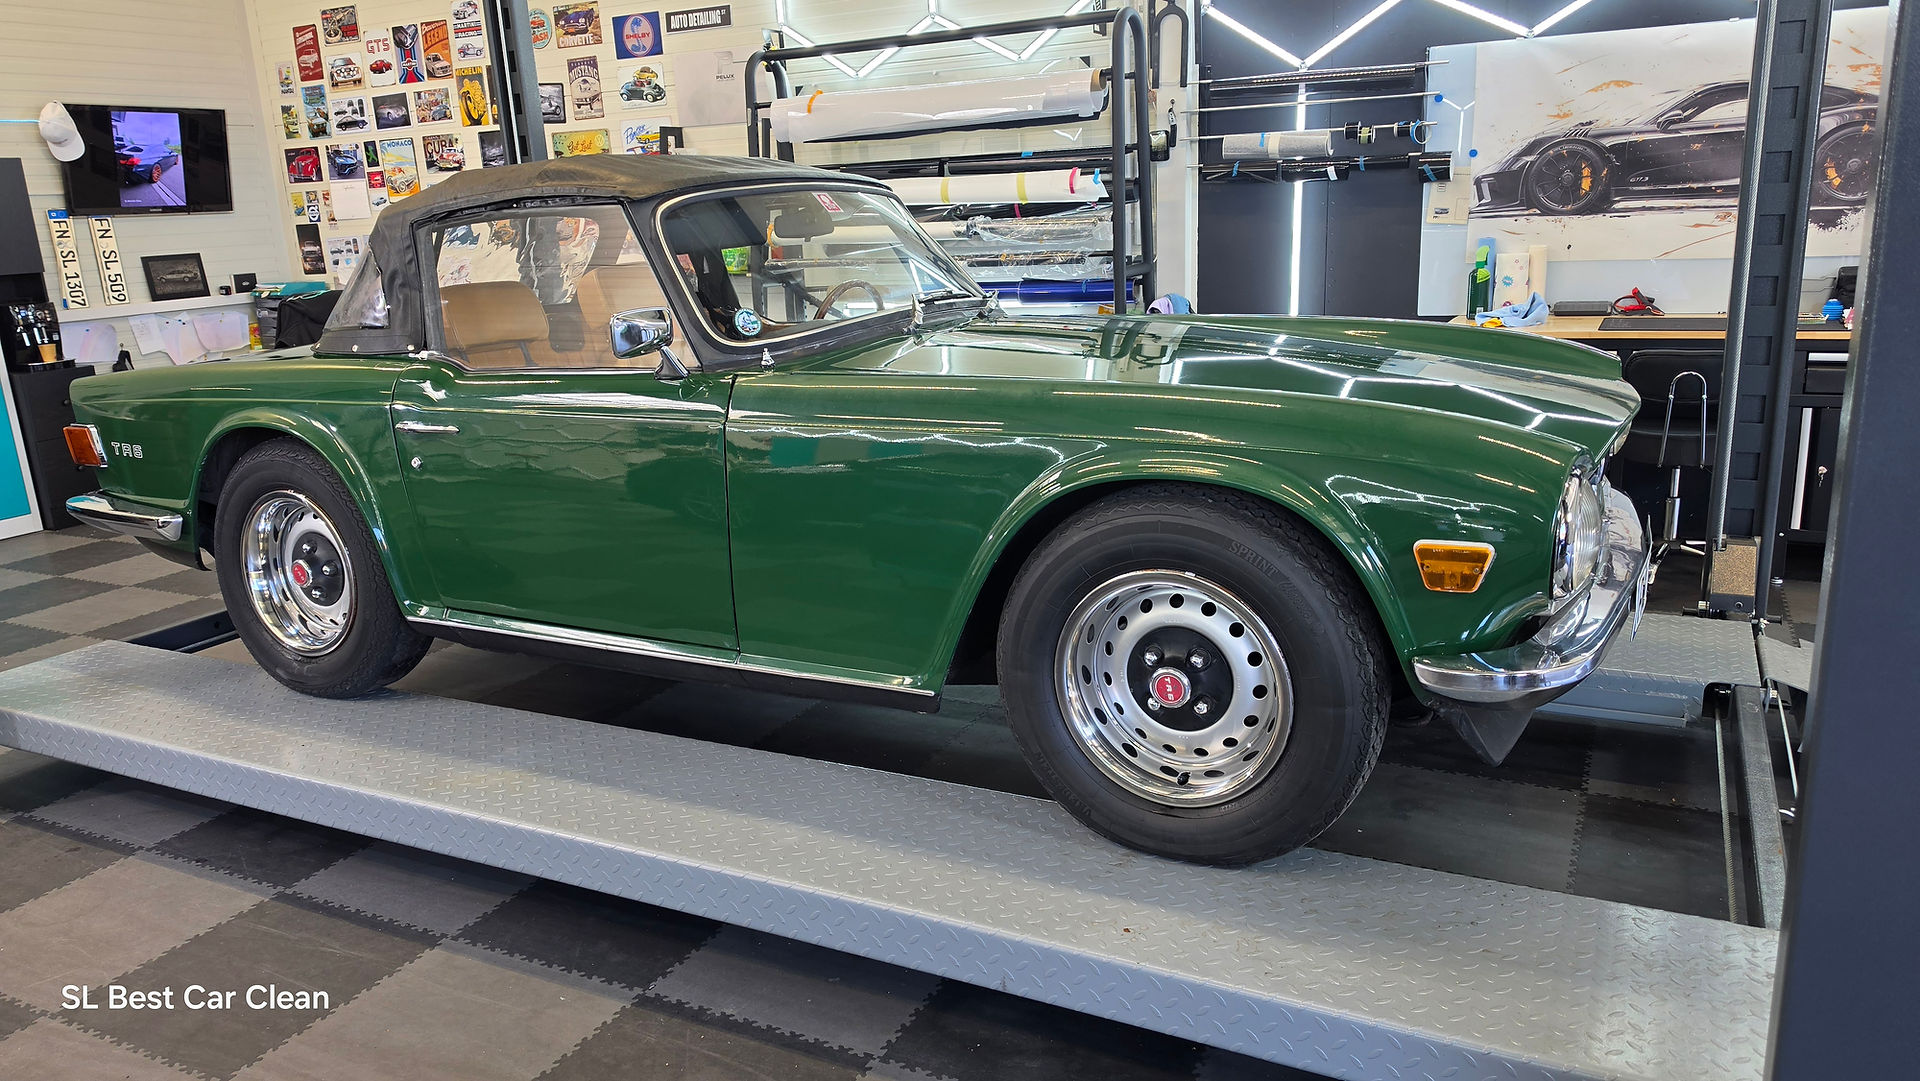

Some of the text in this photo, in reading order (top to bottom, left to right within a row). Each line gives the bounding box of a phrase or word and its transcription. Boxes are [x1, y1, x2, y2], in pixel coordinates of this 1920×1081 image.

[670, 14, 688, 30] AUTO
[688, 9, 721, 27] DETAILING
[559, 33, 594, 48] CORVETTE
[625, 32, 650, 40] SHELBY
[366, 37, 390, 55] GTS
[455, 65, 483, 77] MICHELIN
[569, 65, 599, 81] MUSTANG
[386, 139, 412, 149] MONACO
[53, 220, 71, 239] FN
[60, 249, 77, 269] SL
[94, 218, 127, 302] FN SL 509
[64, 272, 87, 307] 1307
[111, 441, 143, 459] TR6
[1228, 541, 1281, 577] SPRINT
